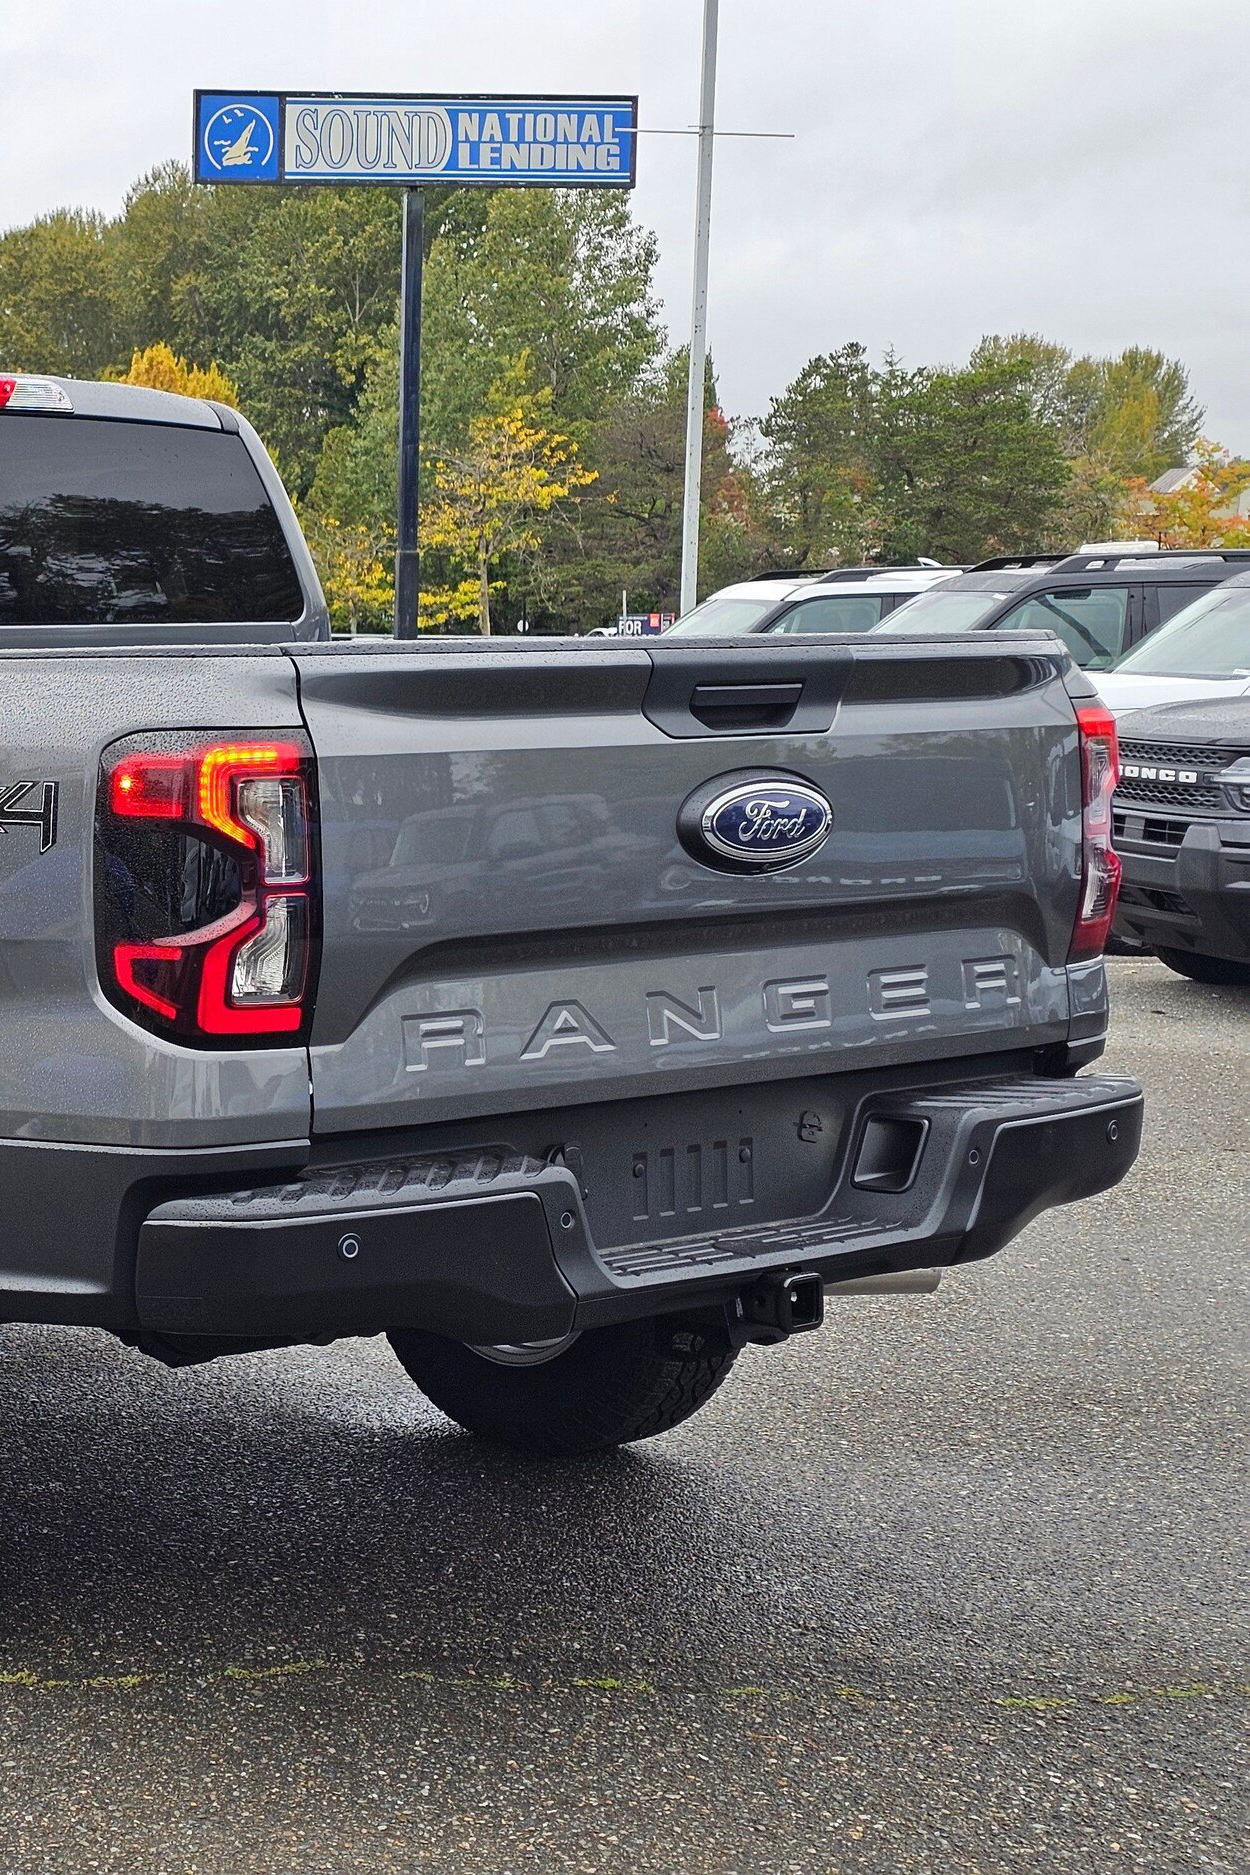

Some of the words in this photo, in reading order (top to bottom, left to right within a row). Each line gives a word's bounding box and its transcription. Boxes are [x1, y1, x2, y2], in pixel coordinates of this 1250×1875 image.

[295, 108, 452, 170] SOUND
[457, 111, 619, 143] NATIONAL
[457, 142, 621, 172] LENDING
[618, 620, 642, 635] FOR
[738, 800, 807, 842] Ford
[401, 954, 1021, 1072] RANGER
